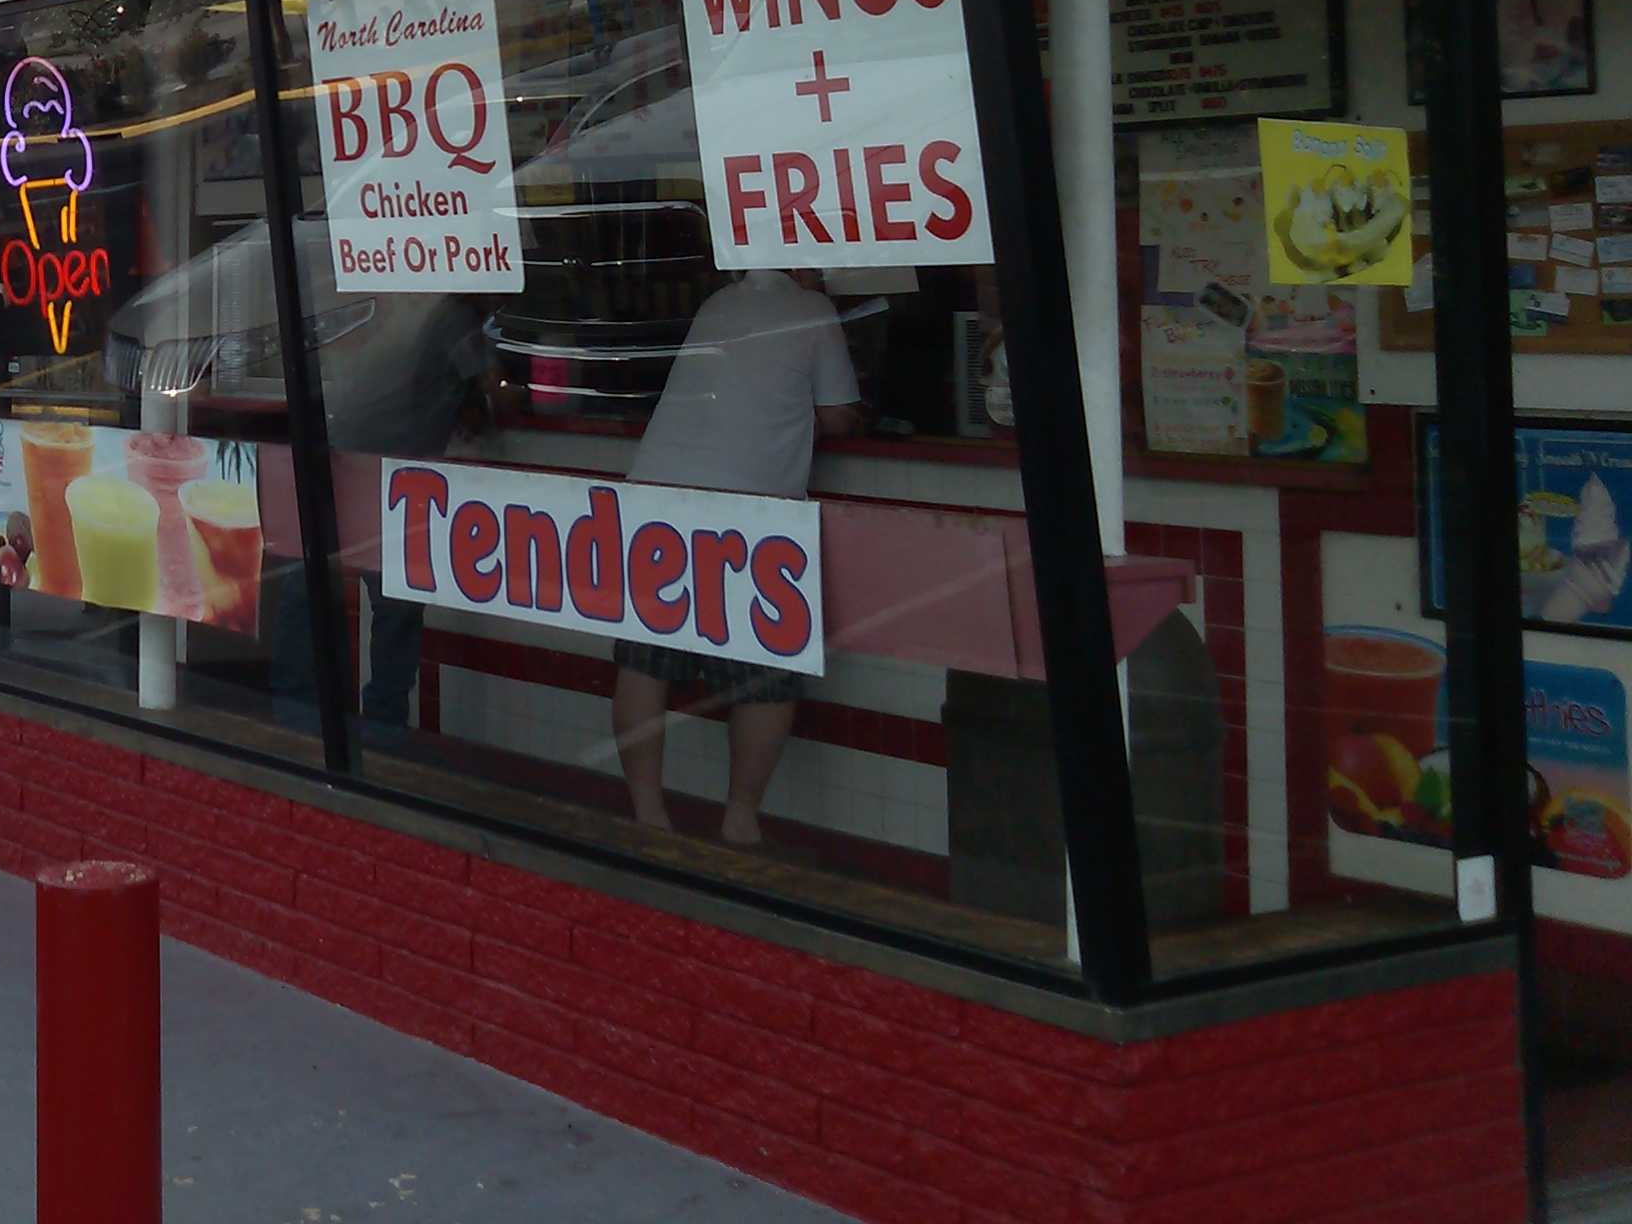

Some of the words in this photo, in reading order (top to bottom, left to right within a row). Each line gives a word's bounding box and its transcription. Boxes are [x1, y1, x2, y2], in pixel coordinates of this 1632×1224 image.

[317, 16, 379, 51] North
[383, 6, 485, 47] Carolina
[321, 62, 496, 174] BBQ
[359, 179, 469, 219] Chicken
[723, 139, 973, 246] FRIES
[0, 239, 111, 319] Open
[339, 233, 397, 274] Beef
[404, 236, 438, 272] Or
[445, 233, 511, 274] Pork
[387, 466, 812, 657] Tenders
